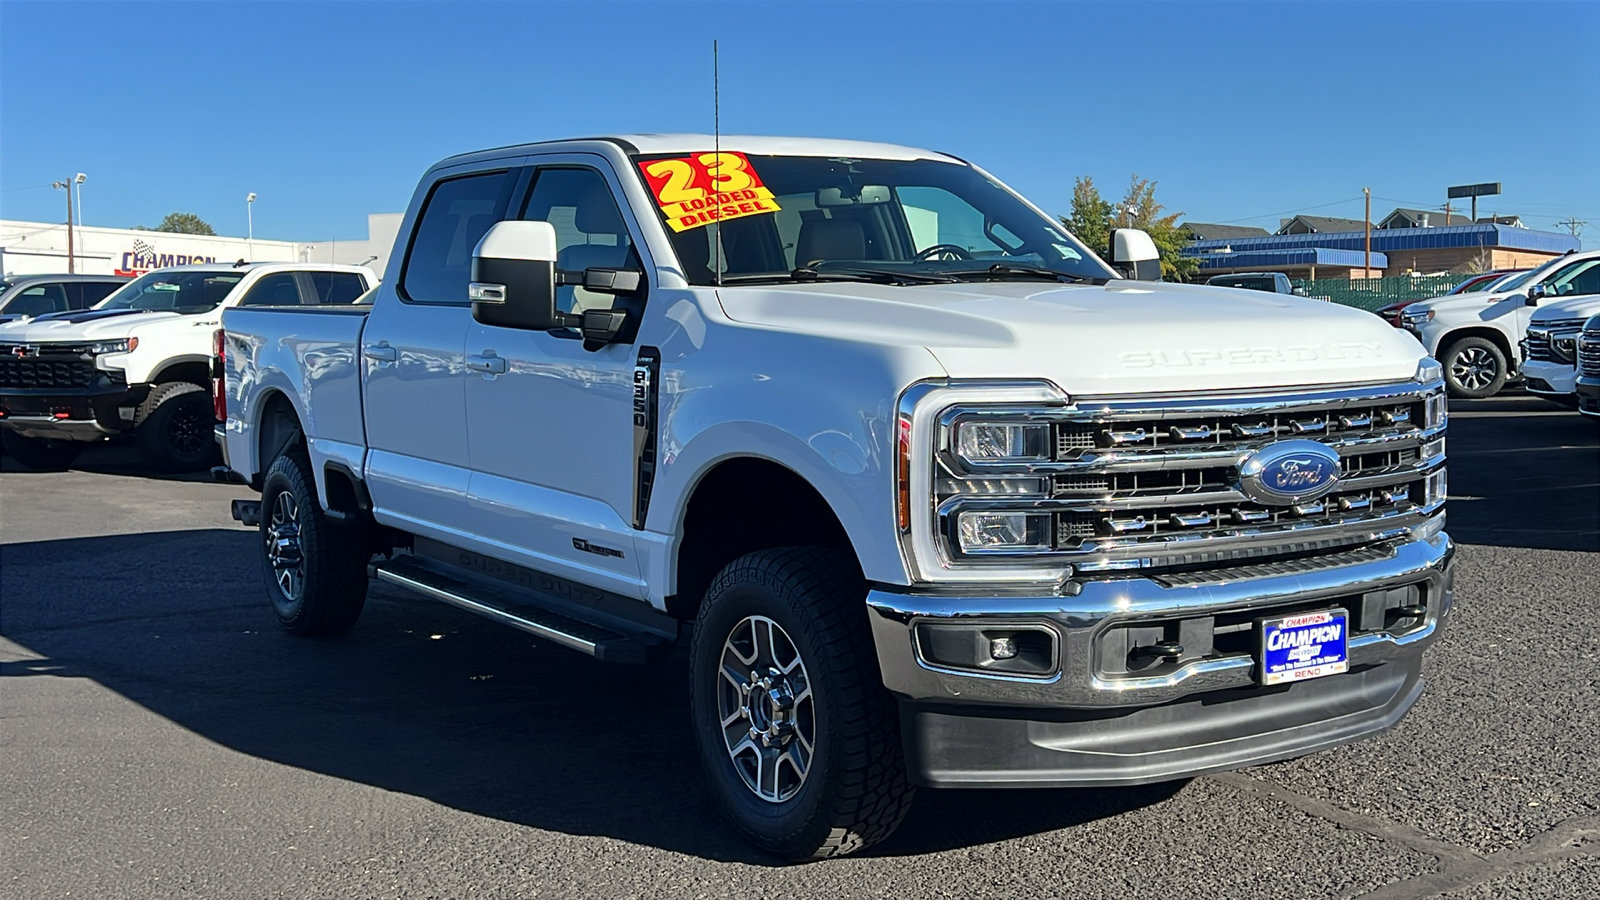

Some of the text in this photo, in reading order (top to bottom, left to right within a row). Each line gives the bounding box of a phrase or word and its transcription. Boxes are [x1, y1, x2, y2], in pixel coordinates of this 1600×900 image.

[646, 152, 756, 204] 23
[679, 189, 758, 213] LOADED
[679, 201, 770, 227] DIESEL
[1119, 342, 1384, 369] SUPER DUTY
[1276, 458, 1322, 488] Ford
[1286, 615, 1326, 628] CHAMPION
[1267, 624, 1342, 651] CHAMPION
[1294, 668, 1321, 678] RENO
